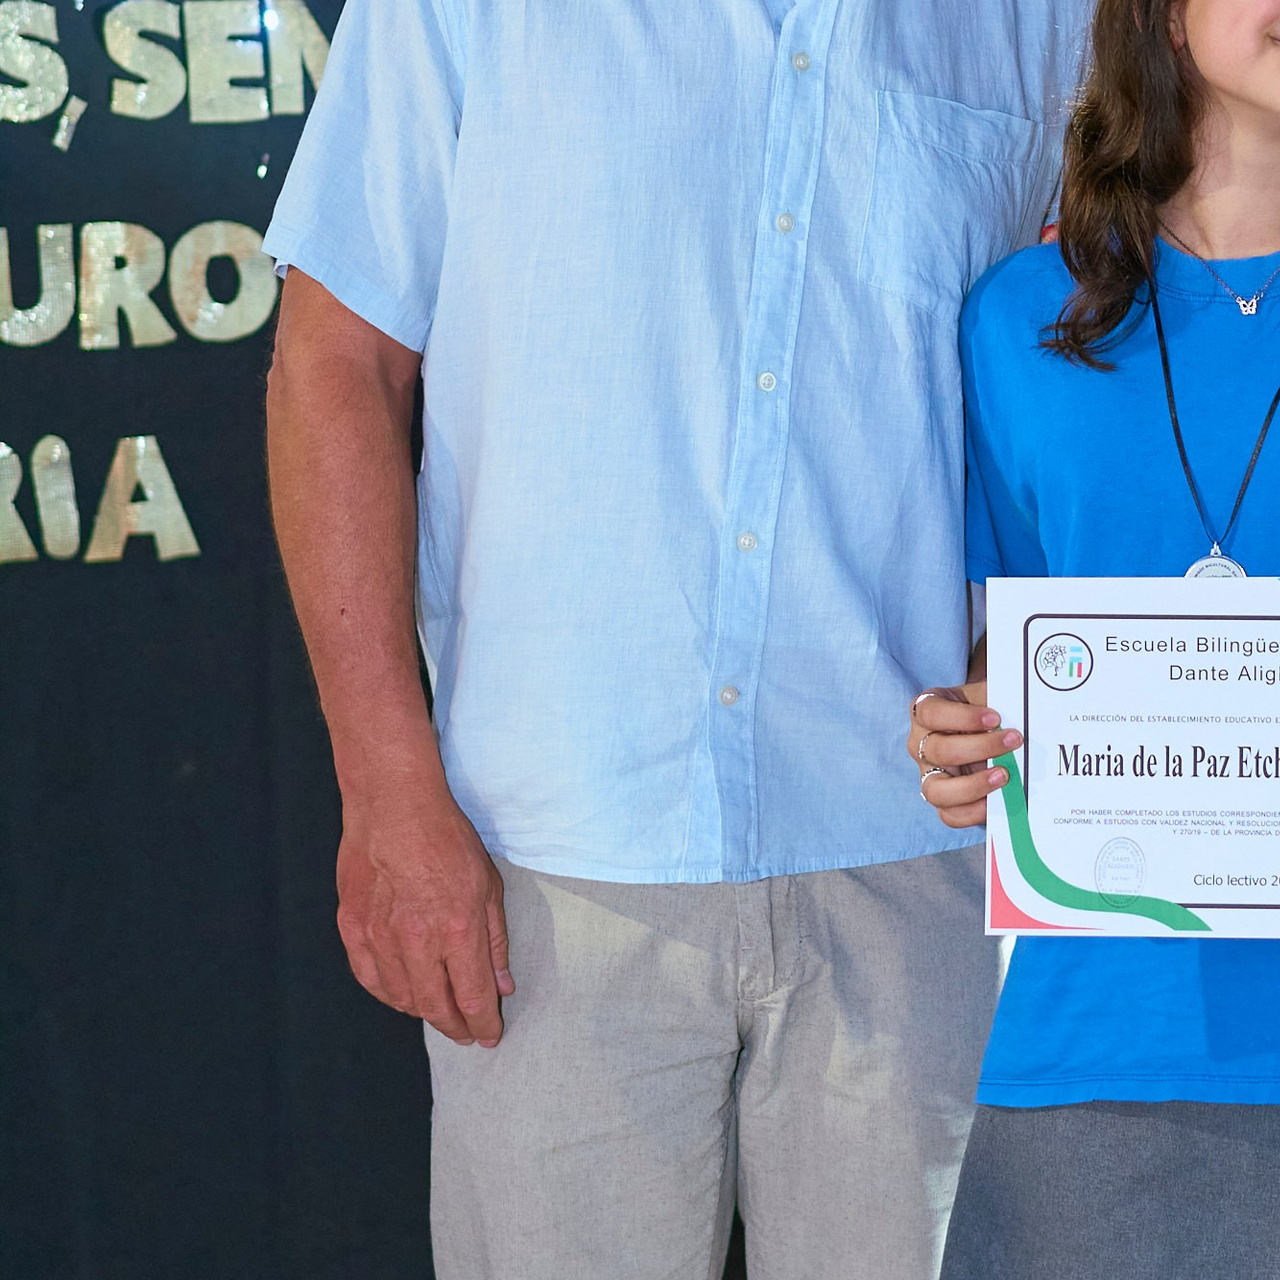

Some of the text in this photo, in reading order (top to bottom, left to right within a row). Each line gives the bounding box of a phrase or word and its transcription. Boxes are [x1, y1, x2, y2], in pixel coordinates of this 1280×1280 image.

[0, 219, 278, 350] URO
[1106, 636, 1187, 653] Escuela
[1197, 637, 1279, 657] Bilingüe
[1169, 665, 1229, 681] Dante
[1069, 714, 1079, 722] LA
[1082, 713, 1127, 722] DIRECCIÓN
[1147, 715, 1221, 723] ESTABLECIMIENTO
[1057, 744, 1124, 777] Maria
[1132, 745, 1157, 777] de
[1164, 745, 1183, 777] la
[1191, 745, 1230, 778] Paz
[1193, 874, 1223, 886] Ciclo
[1227, 874, 1267, 886] lectivo
